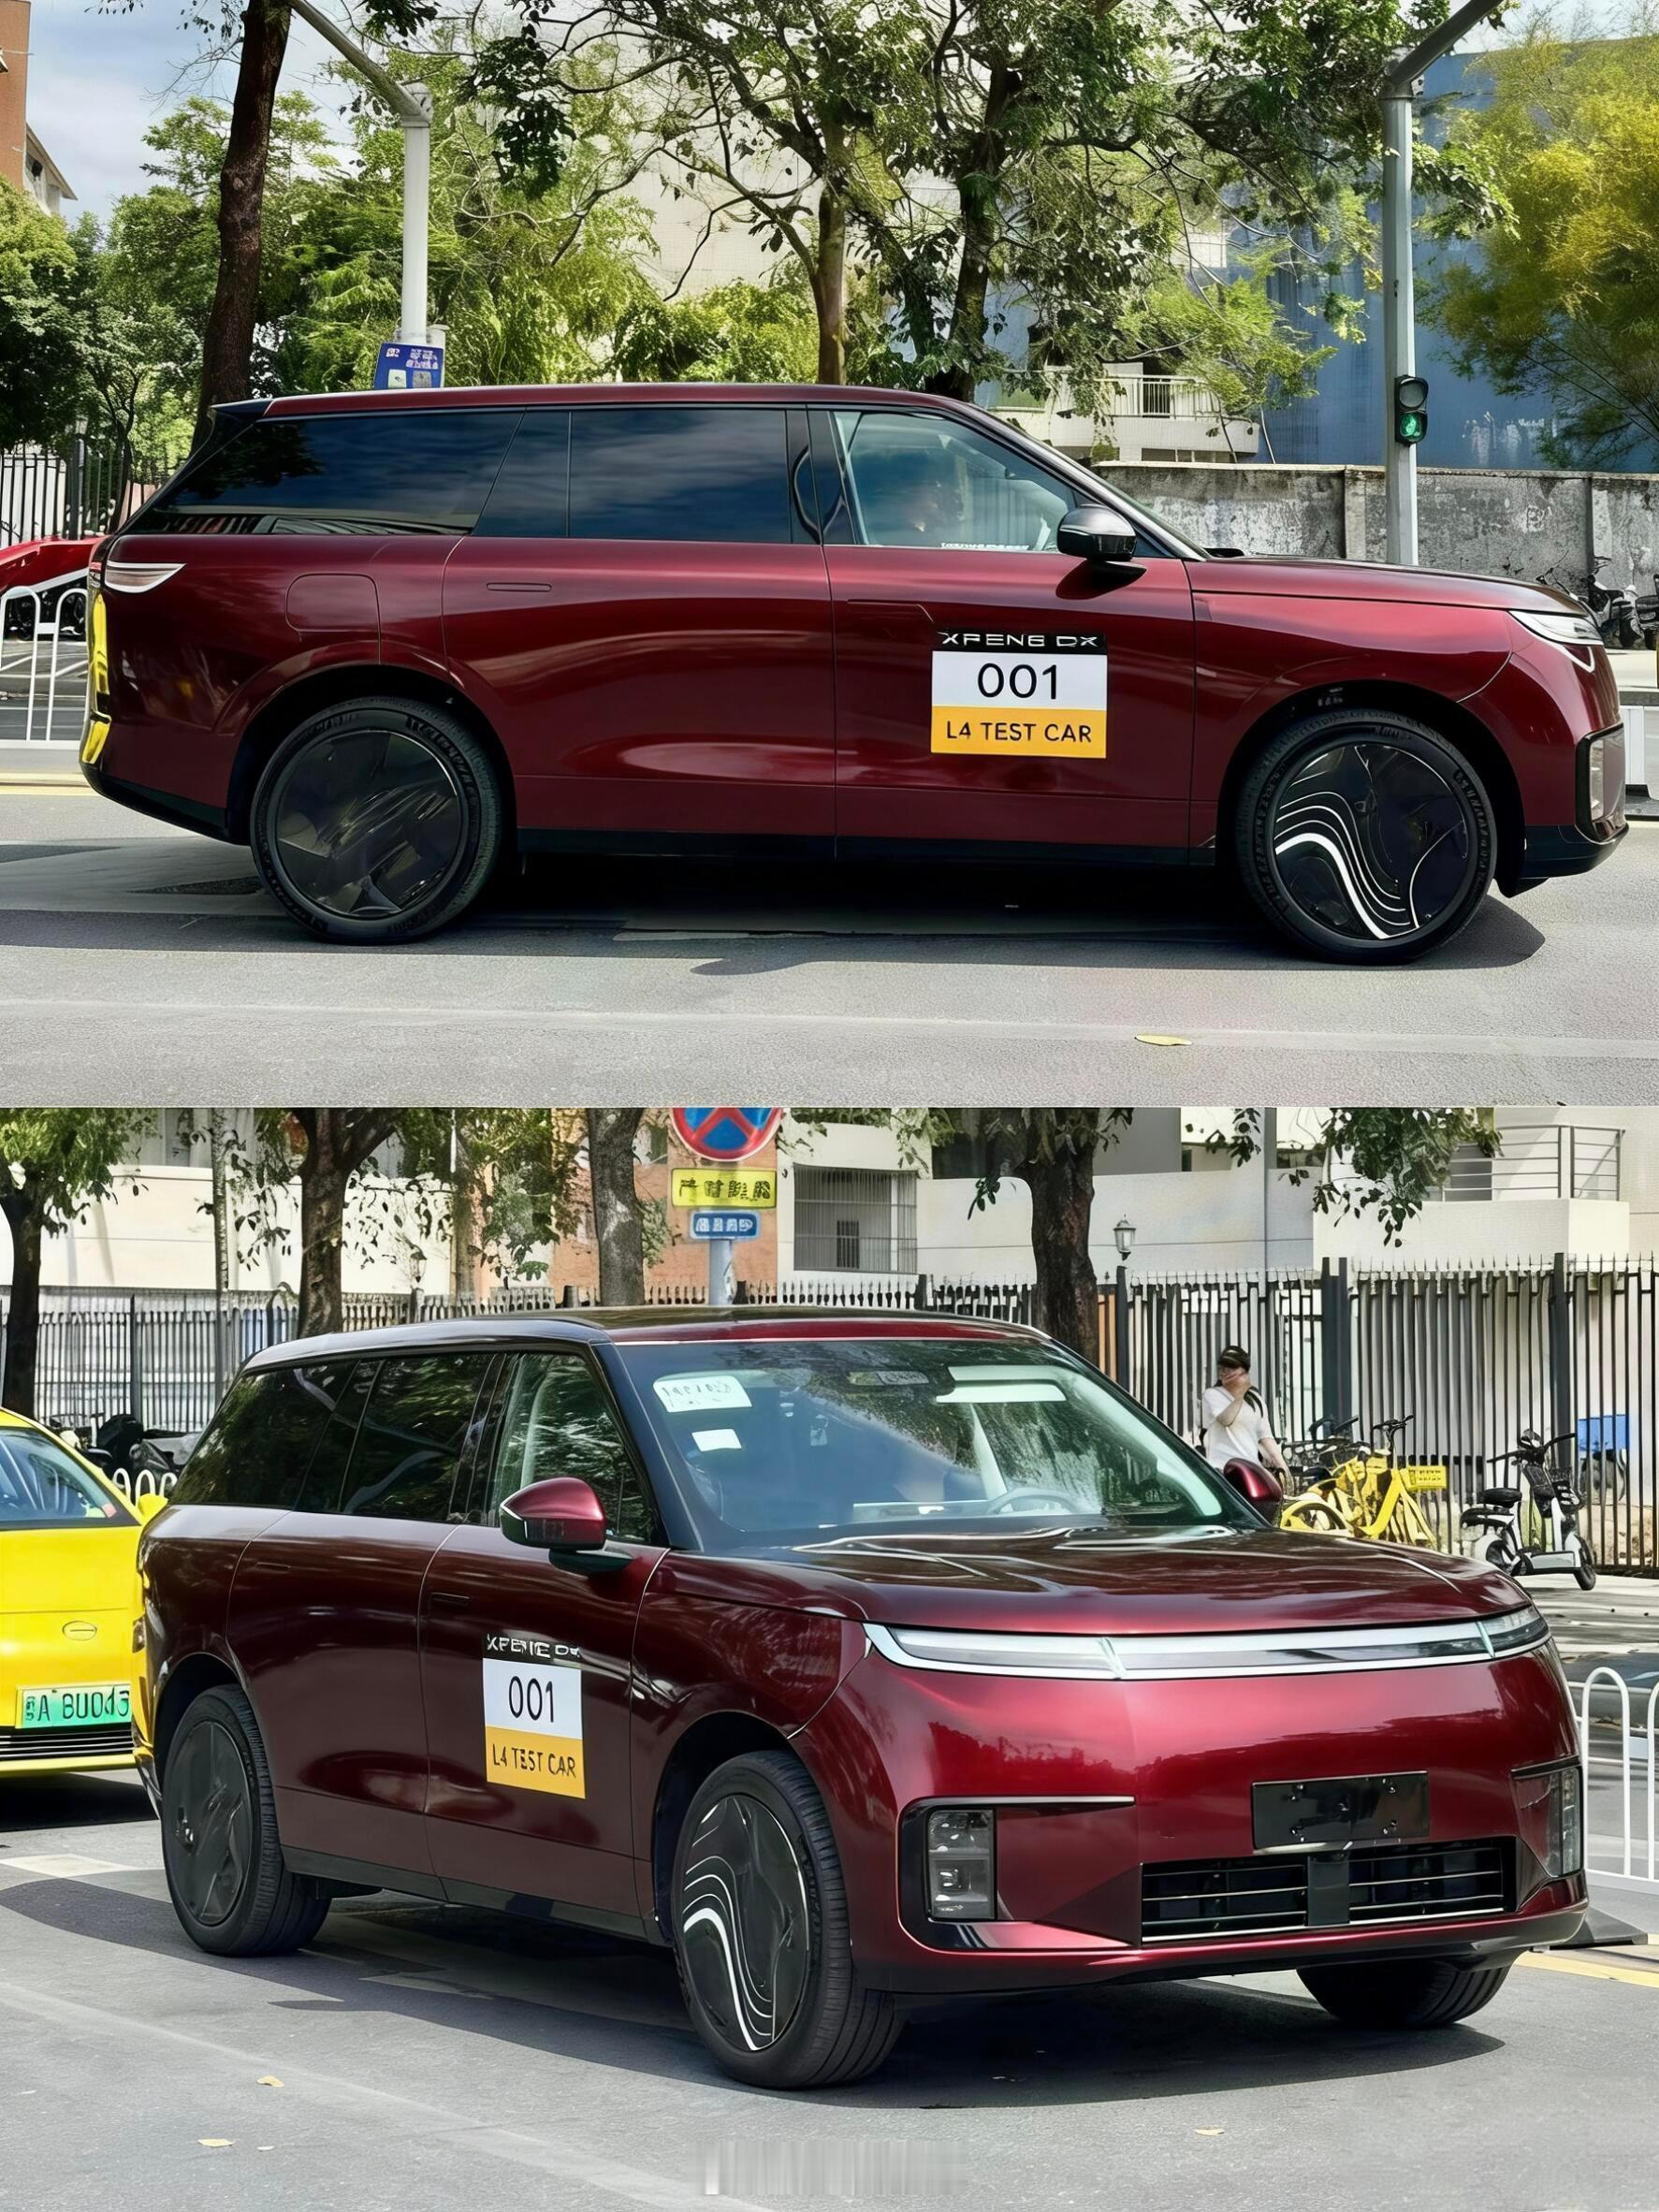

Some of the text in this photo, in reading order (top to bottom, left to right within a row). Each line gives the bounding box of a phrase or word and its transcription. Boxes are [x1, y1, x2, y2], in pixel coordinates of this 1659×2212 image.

[977, 662, 1057, 700] 001
[947, 720, 1092, 743] L4 TEST CAR
[508, 1675, 554, 1723] 001
[492, 1743, 576, 1779] L4 TEST CAR
